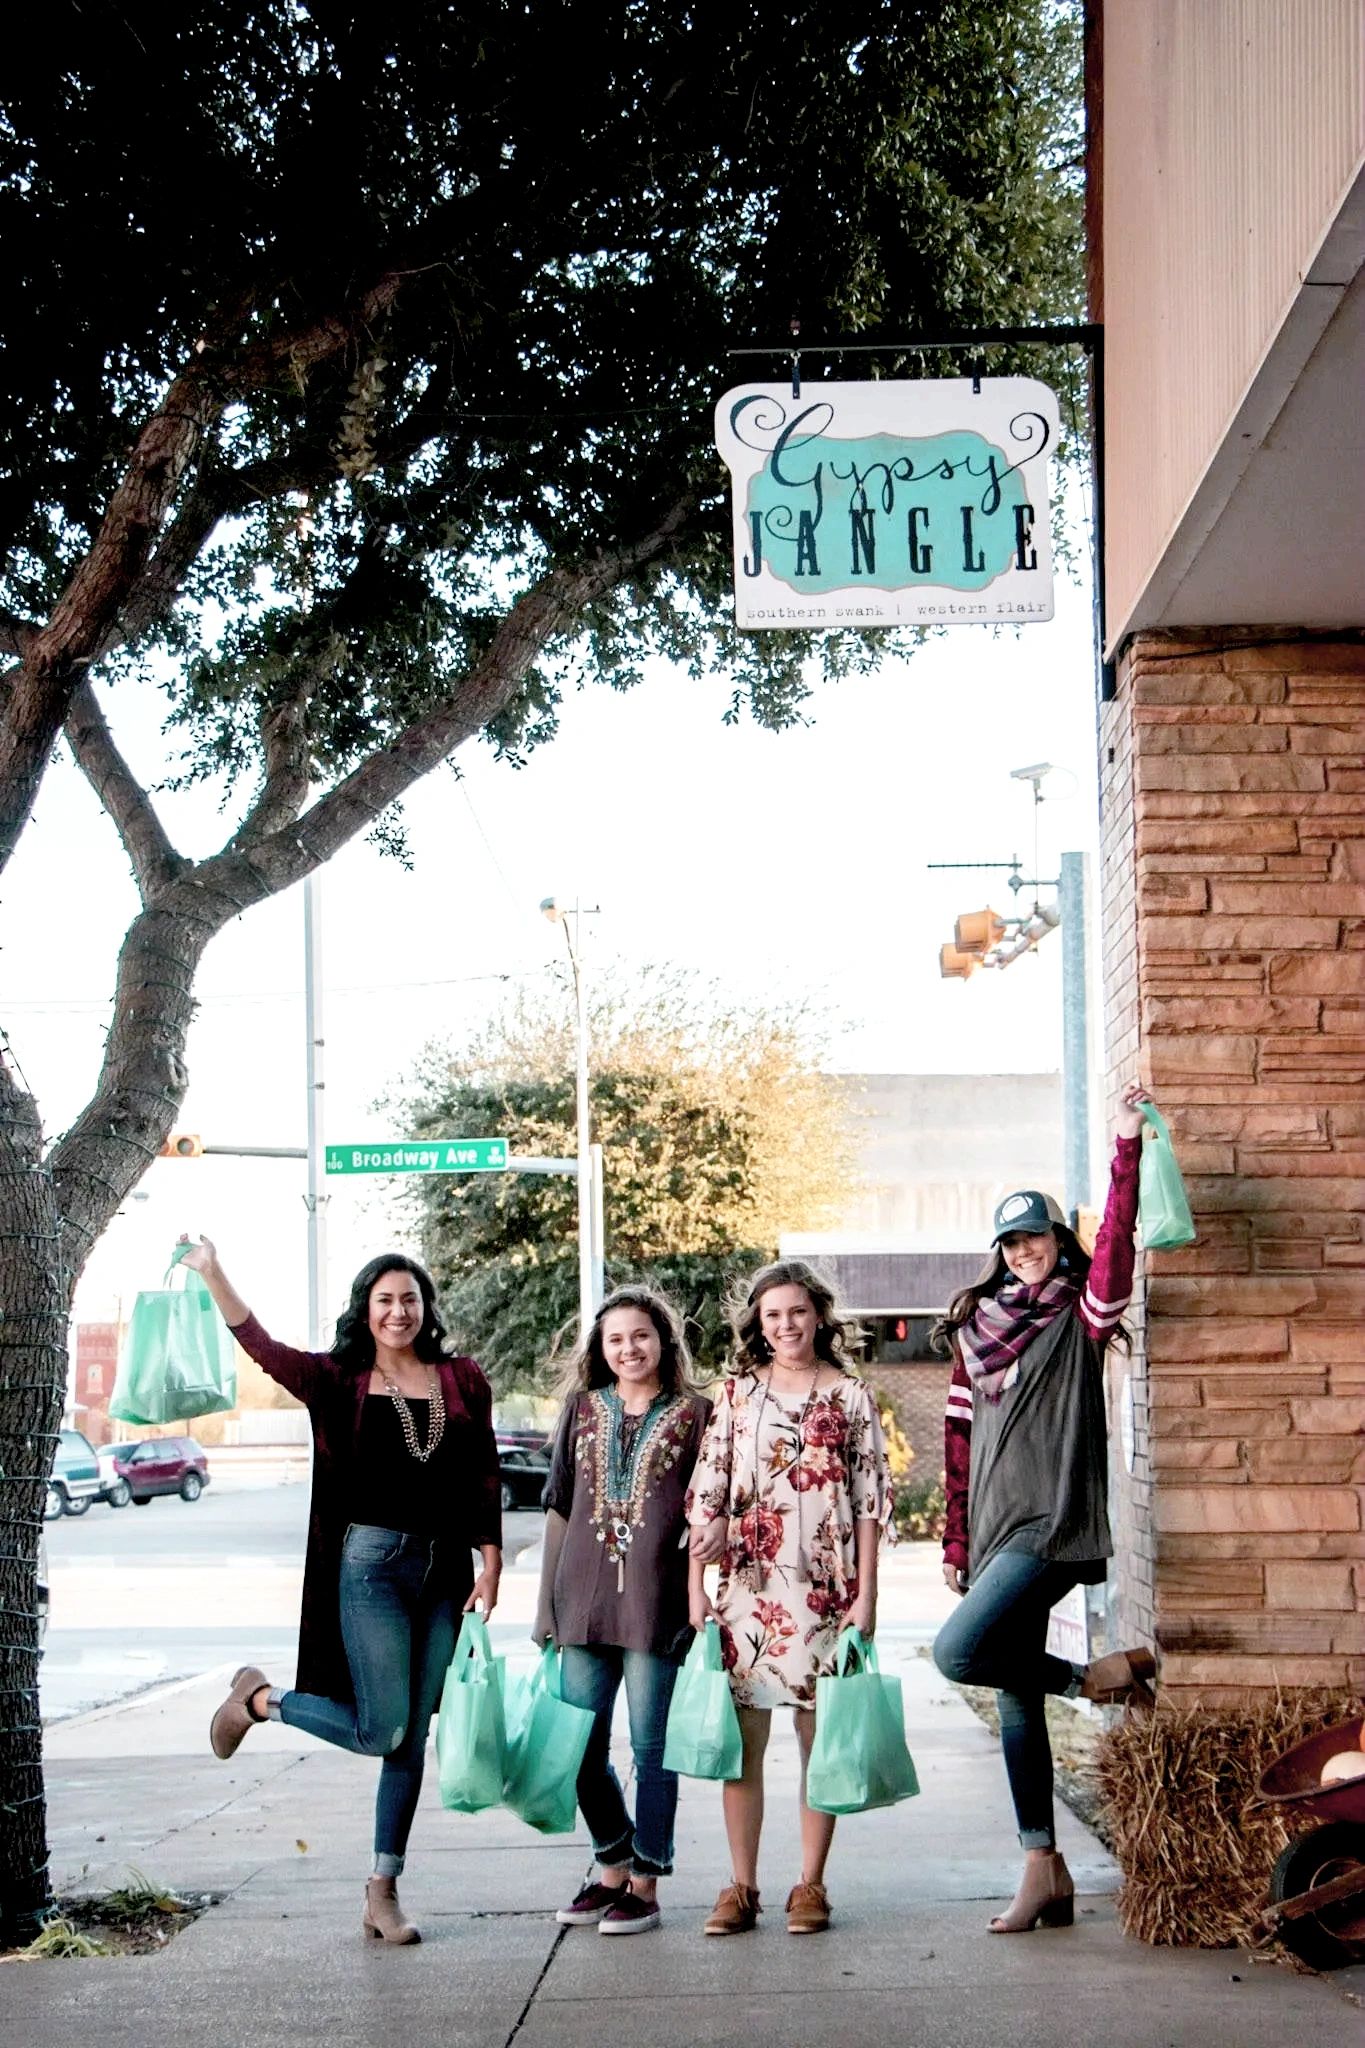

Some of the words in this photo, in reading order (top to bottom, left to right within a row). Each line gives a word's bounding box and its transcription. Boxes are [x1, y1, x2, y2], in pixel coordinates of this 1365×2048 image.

[730, 395, 1050, 541] Gypsy
[743, 504, 1038, 578] JANGLE
[747, 606, 827, 619] southern
[835, 604, 885, 617] swank
[917, 602, 988, 615] western
[997, 601, 1047, 613] flair
[352, 1147, 439, 1169] Broadway
[446, 1147, 478, 1164] Ave
